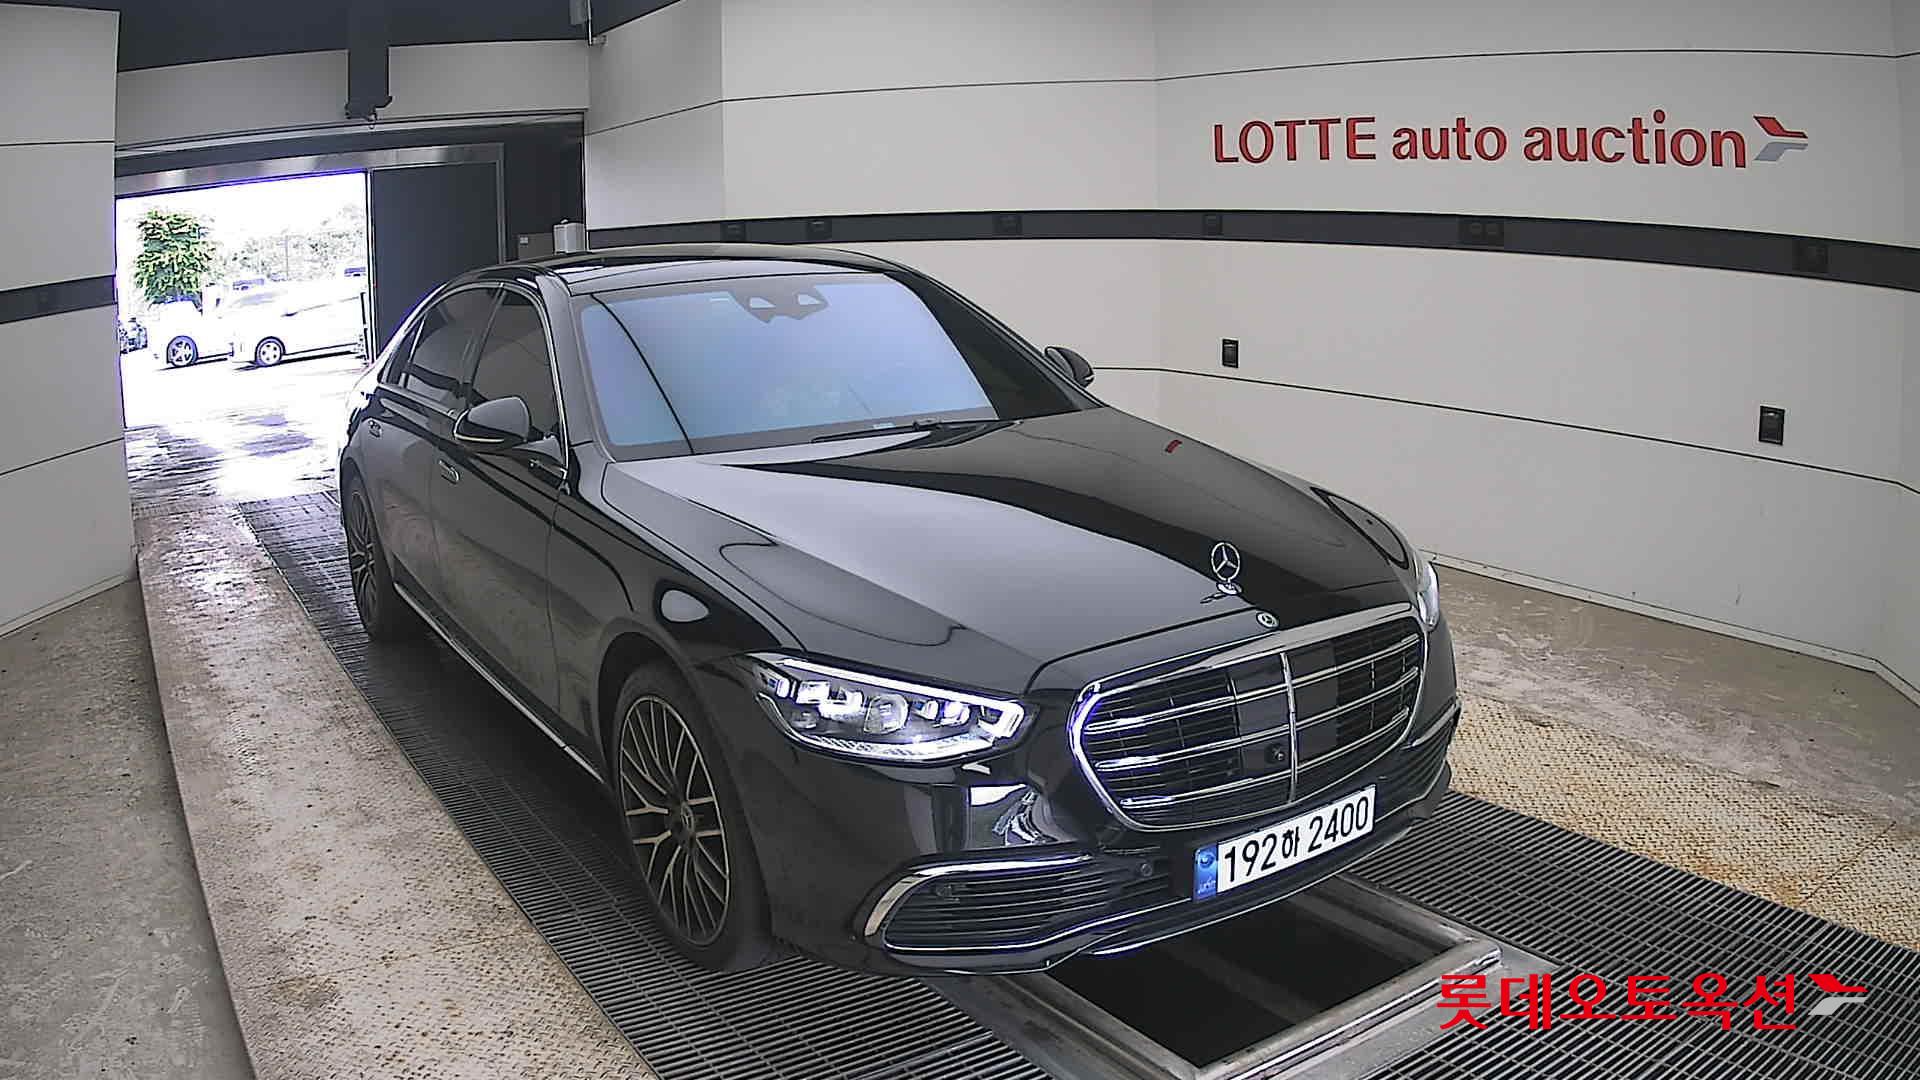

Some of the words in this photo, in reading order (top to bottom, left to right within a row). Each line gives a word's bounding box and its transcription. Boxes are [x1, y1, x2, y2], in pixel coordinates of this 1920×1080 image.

[1213, 116, 1377, 163] LOTTE
[1392, 117, 1508, 162] auto
[1523, 109, 1747, 169] auction
[1224, 826, 1300, 883] 192하
[1307, 796, 1369, 853] 2400
